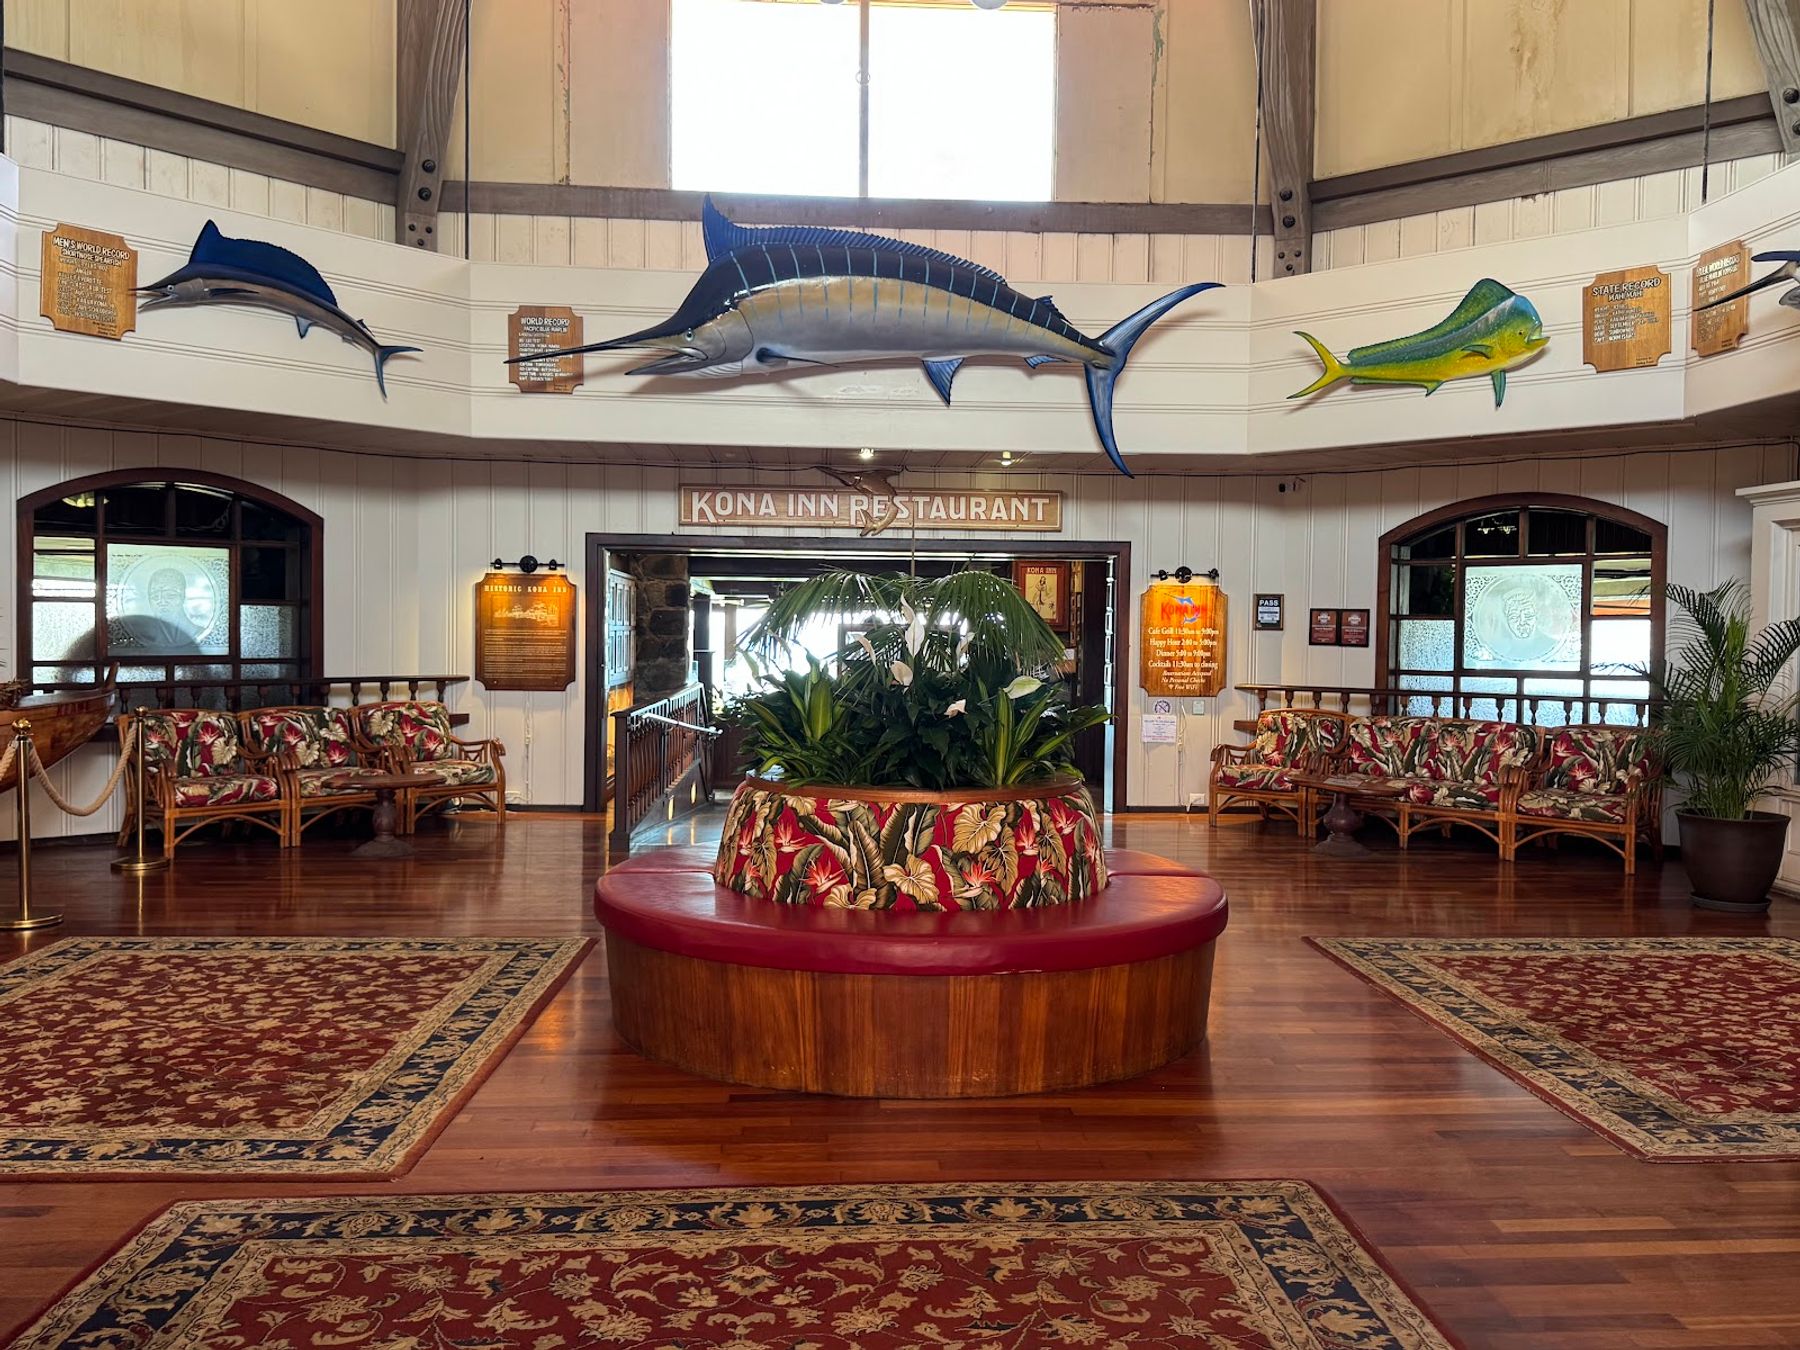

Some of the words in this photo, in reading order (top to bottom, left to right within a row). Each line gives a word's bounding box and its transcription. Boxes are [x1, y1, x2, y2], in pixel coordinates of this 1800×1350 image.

[77, 241, 100, 254] WORLD
[102, 247, 130, 260] RECORD
[1592, 283, 1620, 296] STATE
[1622, 277, 1662, 291] RECORD
[521, 317, 543, 326] WORLD
[544, 318, 570, 326] RECORD
[691, 491, 778, 523] KONA
[788, 493, 839, 517] INN
[850, 494, 1050, 526] RESTAURANT
[484, 585, 522, 593] HISTORIC
[1259, 599, 1279, 607] PASS
[1149, 638, 1166, 647] Happy
[1167, 638, 1181, 646] Hour
